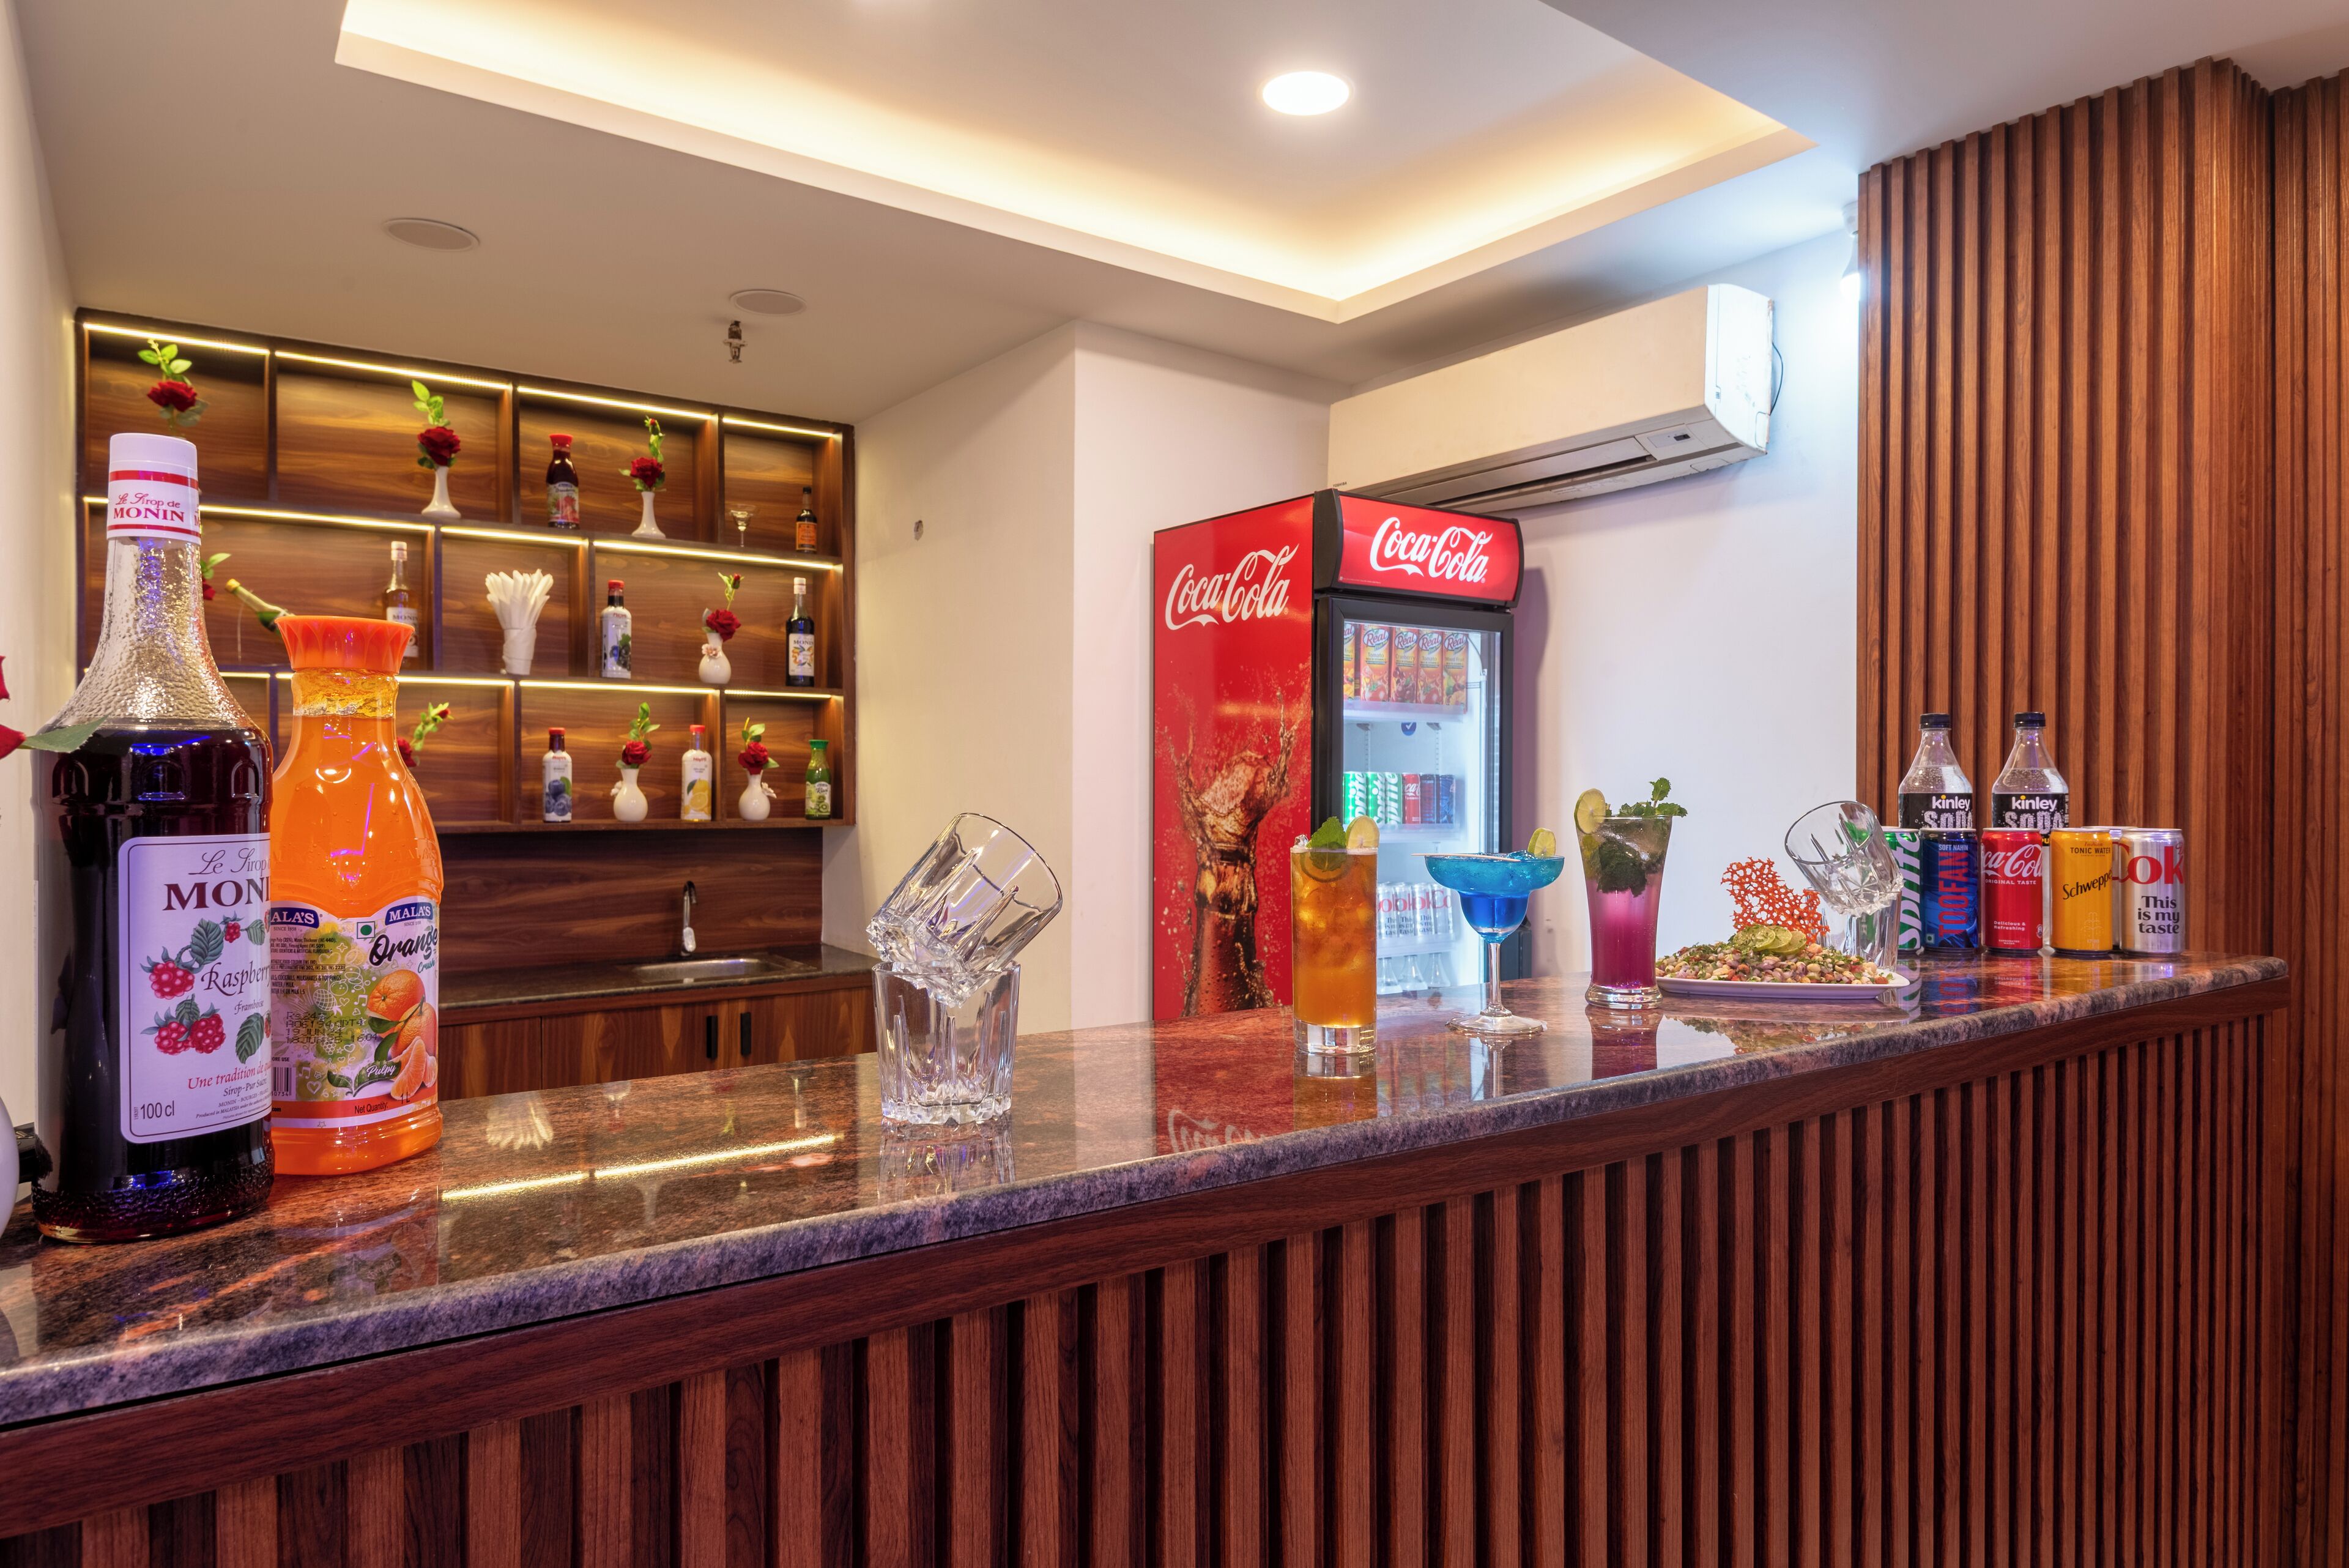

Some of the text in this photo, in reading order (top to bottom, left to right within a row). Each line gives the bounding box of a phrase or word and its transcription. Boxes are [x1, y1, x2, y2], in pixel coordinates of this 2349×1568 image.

[116, 492, 180, 508] Le Sirop de
[114, 507, 185, 522] MONIN
[1370, 517, 1493, 583] Coca-Cola
[1165, 543, 1299, 630] Coca-Cola
[1366, 631, 1386, 647] Real
[1397, 634, 1415, 648] Real
[1421, 634, 1439, 650] Real
[1447, 634, 1464, 652] Real
[1932, 795, 1970, 811] kinley
[2011, 795, 2058, 811] kinley
[188, 848, 267, 877] Le Sirop
[1938, 852, 1969, 937] TOOFAN
[2142, 896, 2176, 908] This
[2137, 908, 2180, 923] is my
[2139, 923, 2180, 934] taste
[369, 925, 438, 966] Orange
[418, 958, 435, 973] Crush
[188, 1077, 212, 1090] Une
[215, 1067, 256, 1085] tradition
[257, 1061, 264, 1074] de
[366, 1065, 396, 1077] Pulpy
[141, 1101, 174, 1119] 100 cl
[218, 1099, 237, 1107] MONIN
[355, 1105, 365, 1114] Net
[406, 1091, 410, 1103] L
